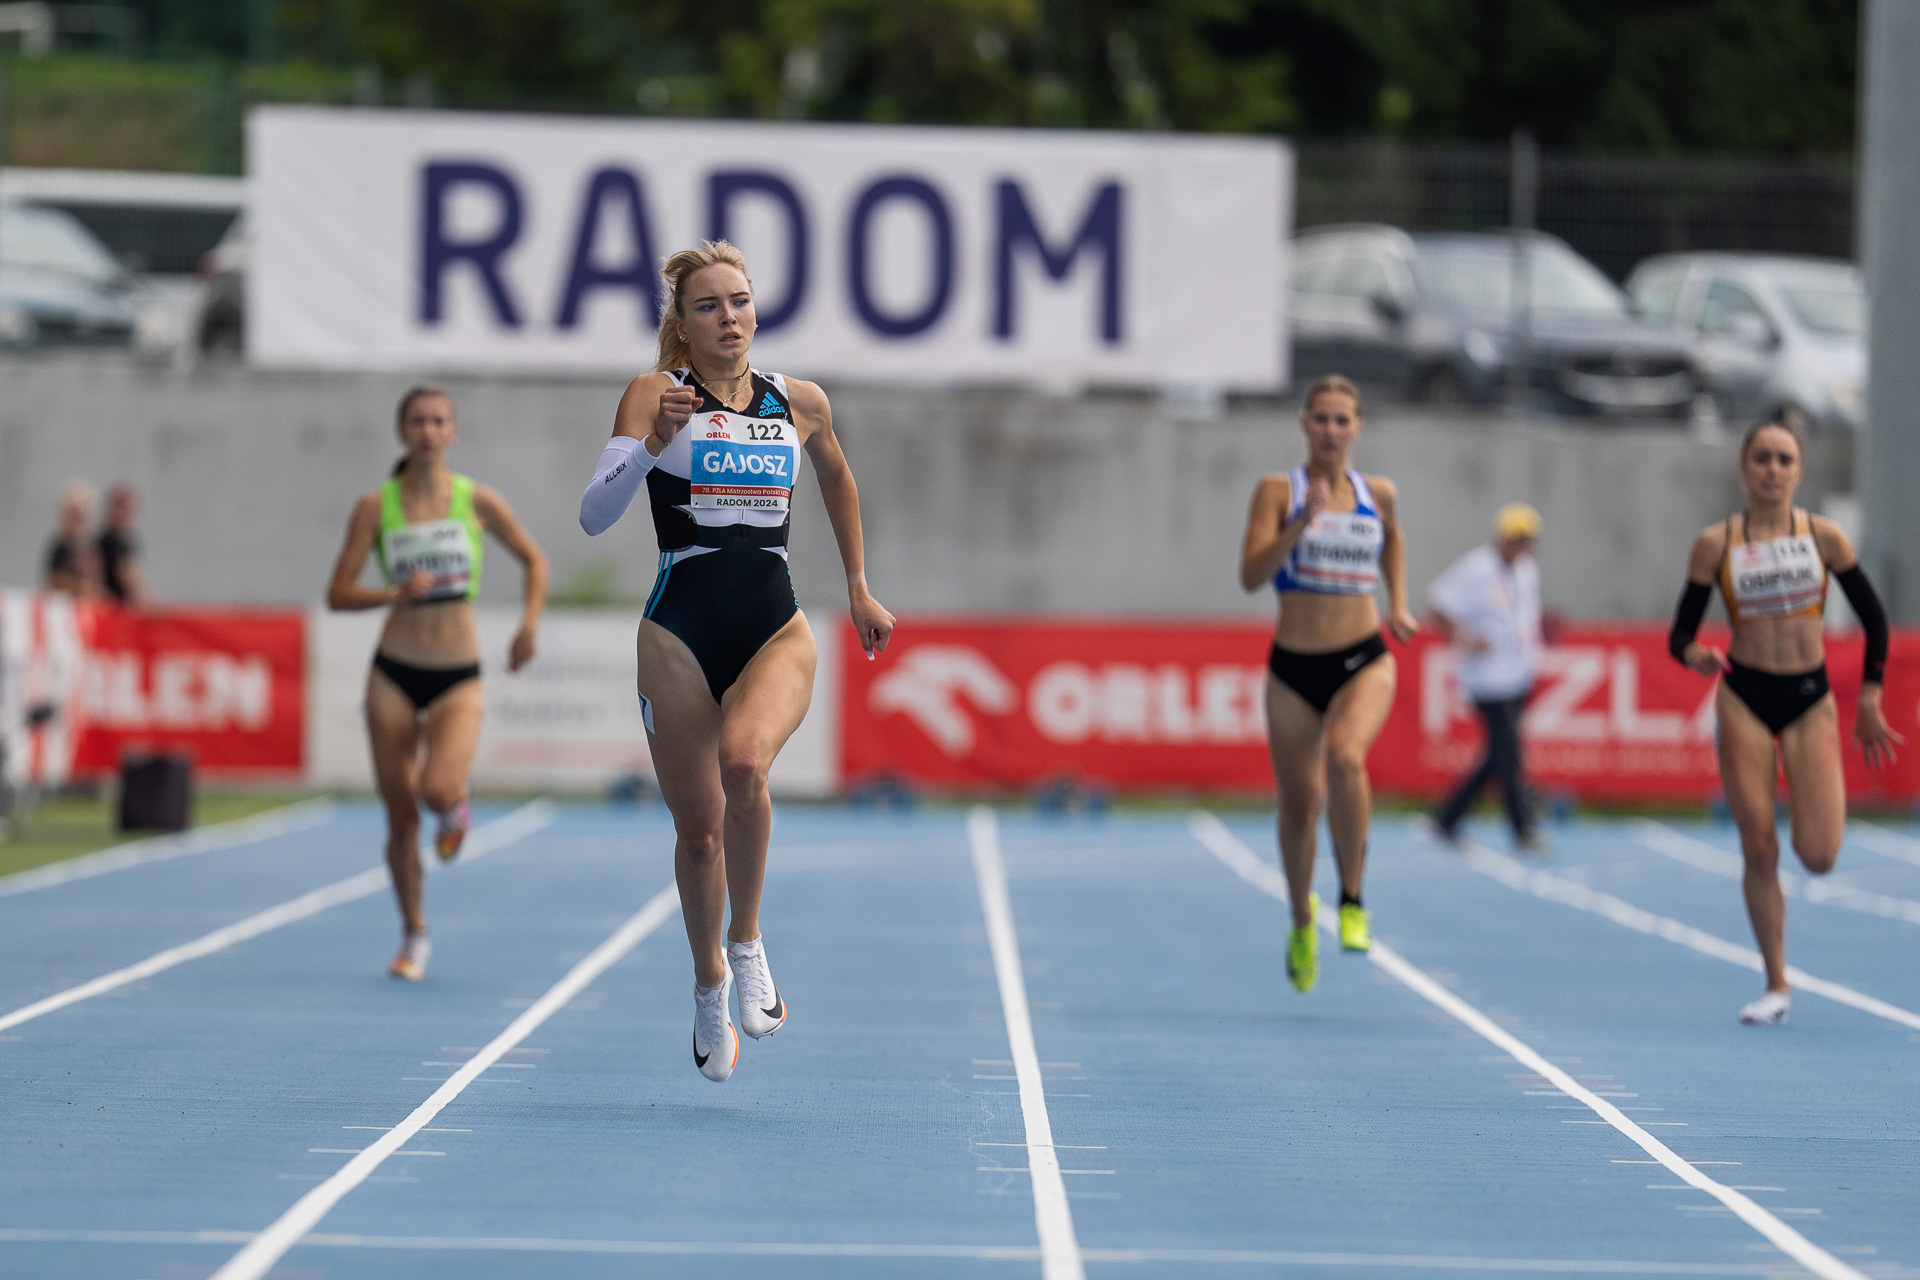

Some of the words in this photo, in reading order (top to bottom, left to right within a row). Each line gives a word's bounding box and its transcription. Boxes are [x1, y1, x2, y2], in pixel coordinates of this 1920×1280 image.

[418, 159, 1126, 347] RADOM
[758, 405, 785, 417] adidas
[705, 431, 731, 440] ORLEN
[746, 423, 785, 441] 122
[604, 460, 628, 485] ALLSIX
[702, 451, 788, 476] GAJOSZ
[716, 498, 752, 507] RADOM
[753, 499, 779, 507] 2024
